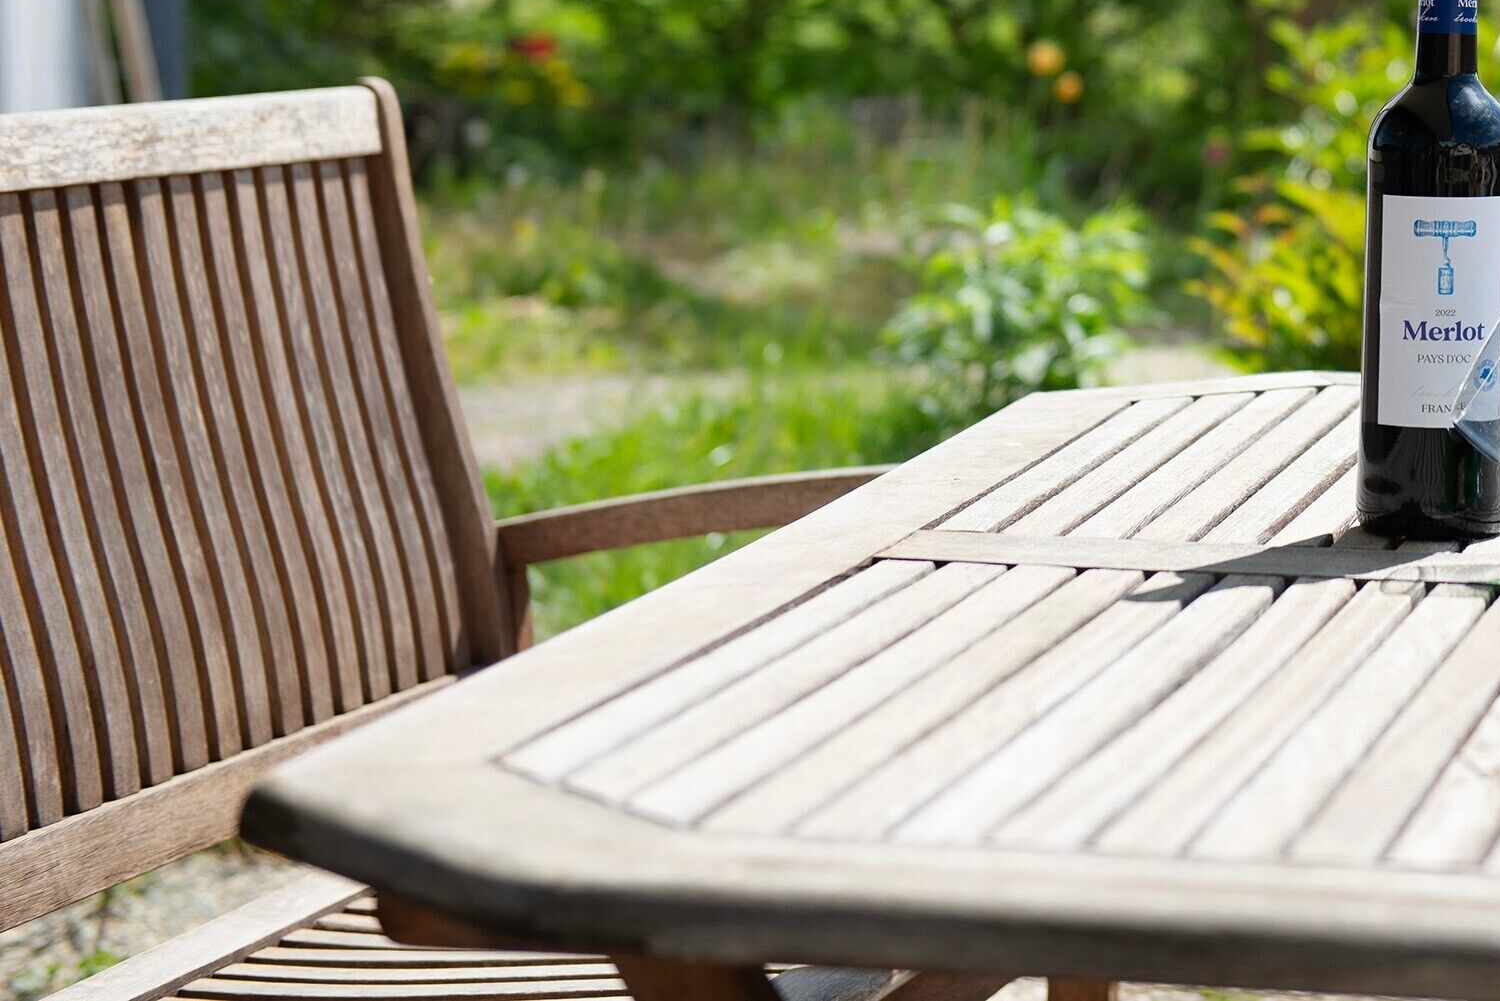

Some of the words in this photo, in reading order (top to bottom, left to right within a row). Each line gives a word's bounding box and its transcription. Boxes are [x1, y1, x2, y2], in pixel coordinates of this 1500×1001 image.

[1435, 309, 1456, 317] 2022
[1402, 319, 1485, 342] Merlot
[1417, 353, 1445, 364] PAYS
[1446, 353, 1472, 364] D'OC
[1421, 401, 1467, 413] FRANE
